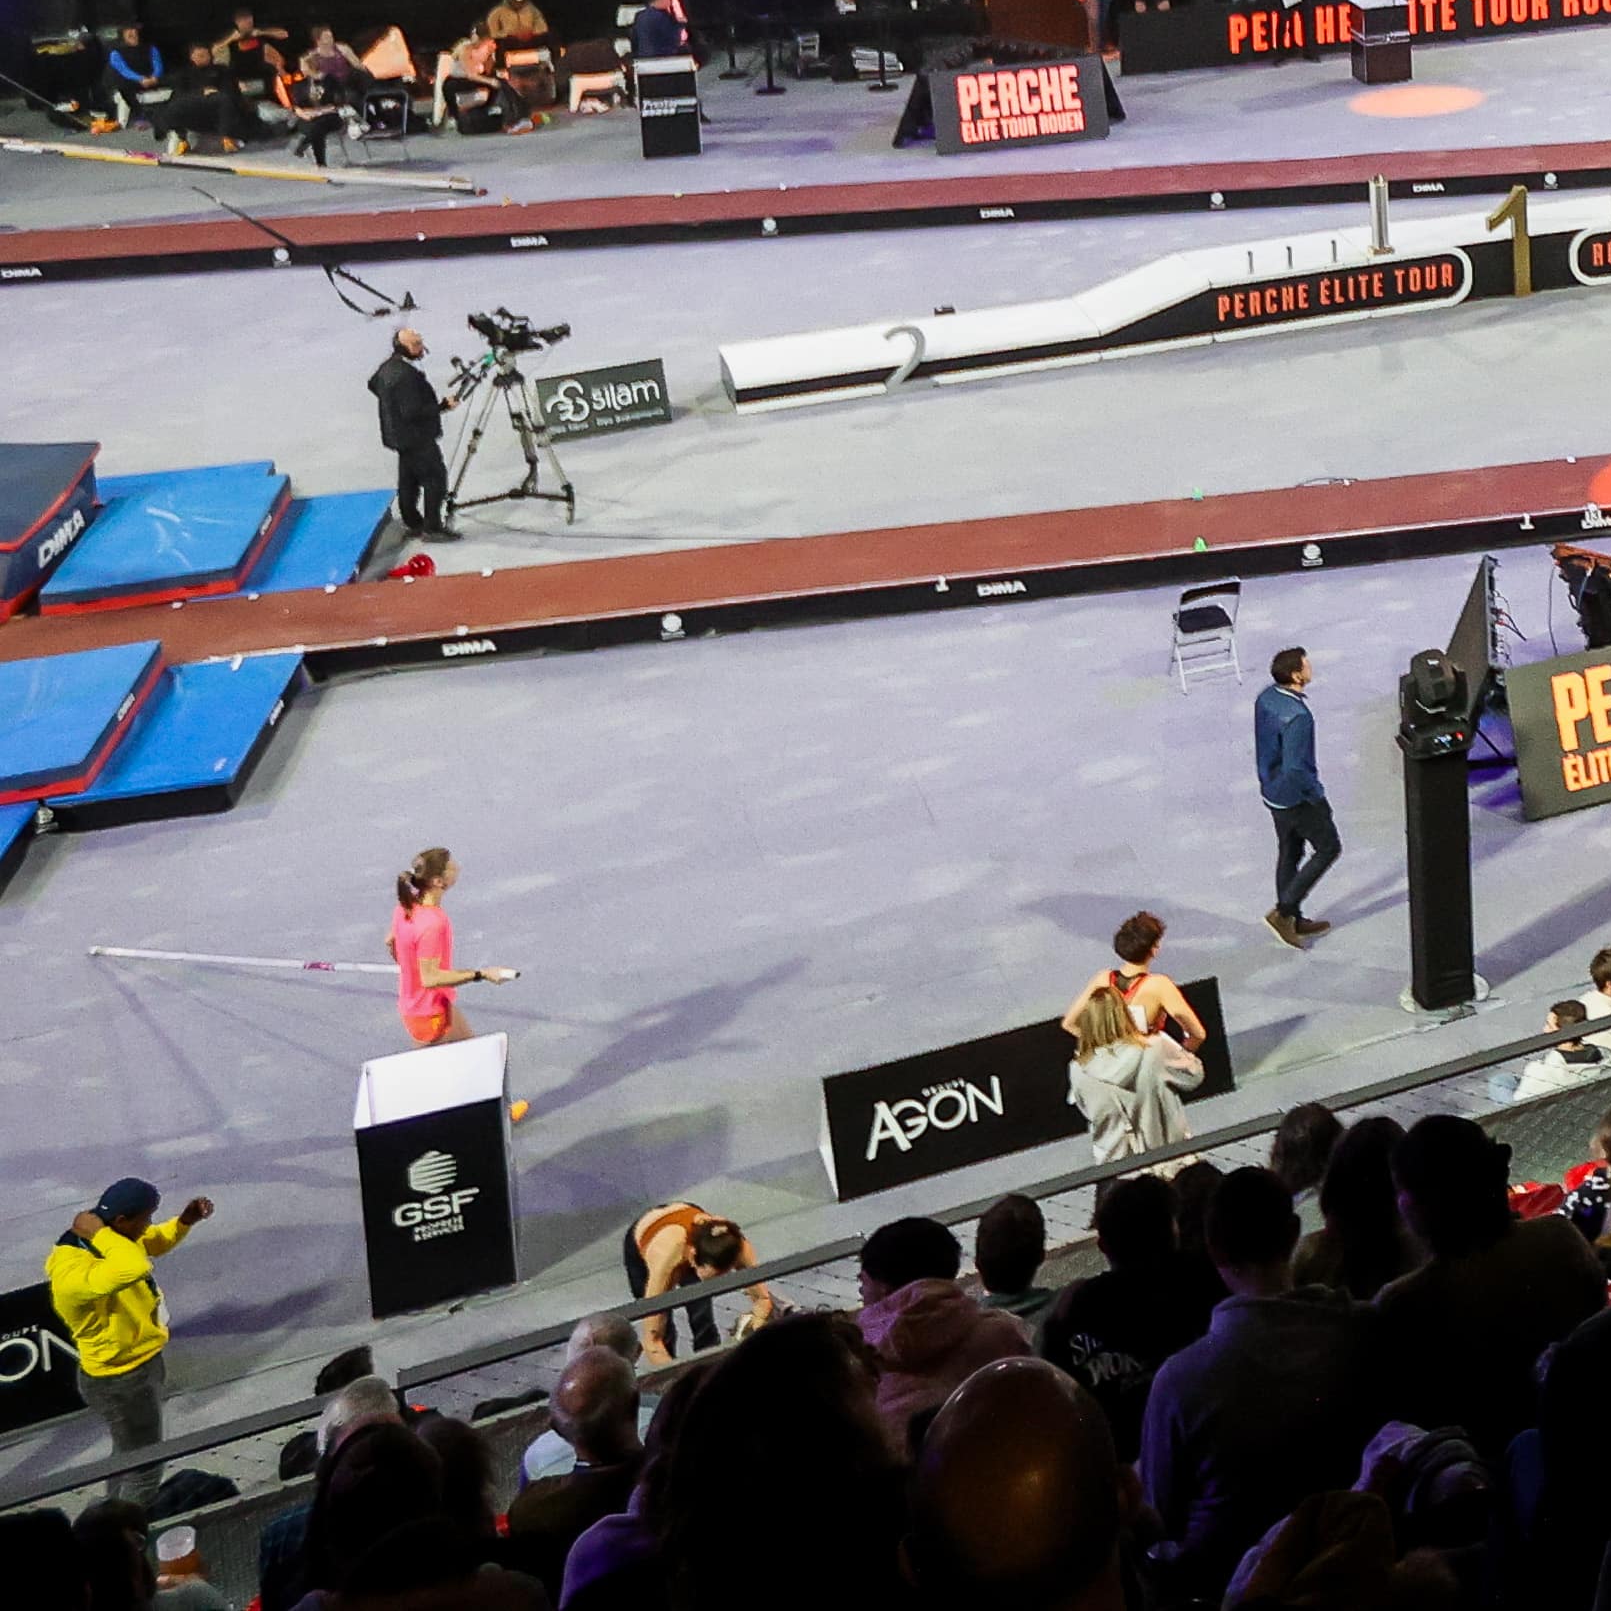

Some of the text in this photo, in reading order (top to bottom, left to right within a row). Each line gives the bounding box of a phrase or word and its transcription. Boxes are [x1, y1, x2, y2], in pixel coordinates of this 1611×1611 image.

[957, 64, 1082, 122] PERCHE
[1001, 115, 1039, 140] TOUR
[1039, 108, 1087, 136] ROUEN
[1486, 184, 1532, 297] 1
[1217, 262, 1455, 321] PERCHE ÉLITE TOUR
[884, 323, 926, 394] 2
[592, 379, 660, 411] silam
[39, 508, 86, 569] DIMA
[977, 580, 1027, 597] DIMA
[442, 640, 496, 657] DIMA
[865, 1075, 1005, 1162] AGON
[392, 1187, 480, 1228] GSF
